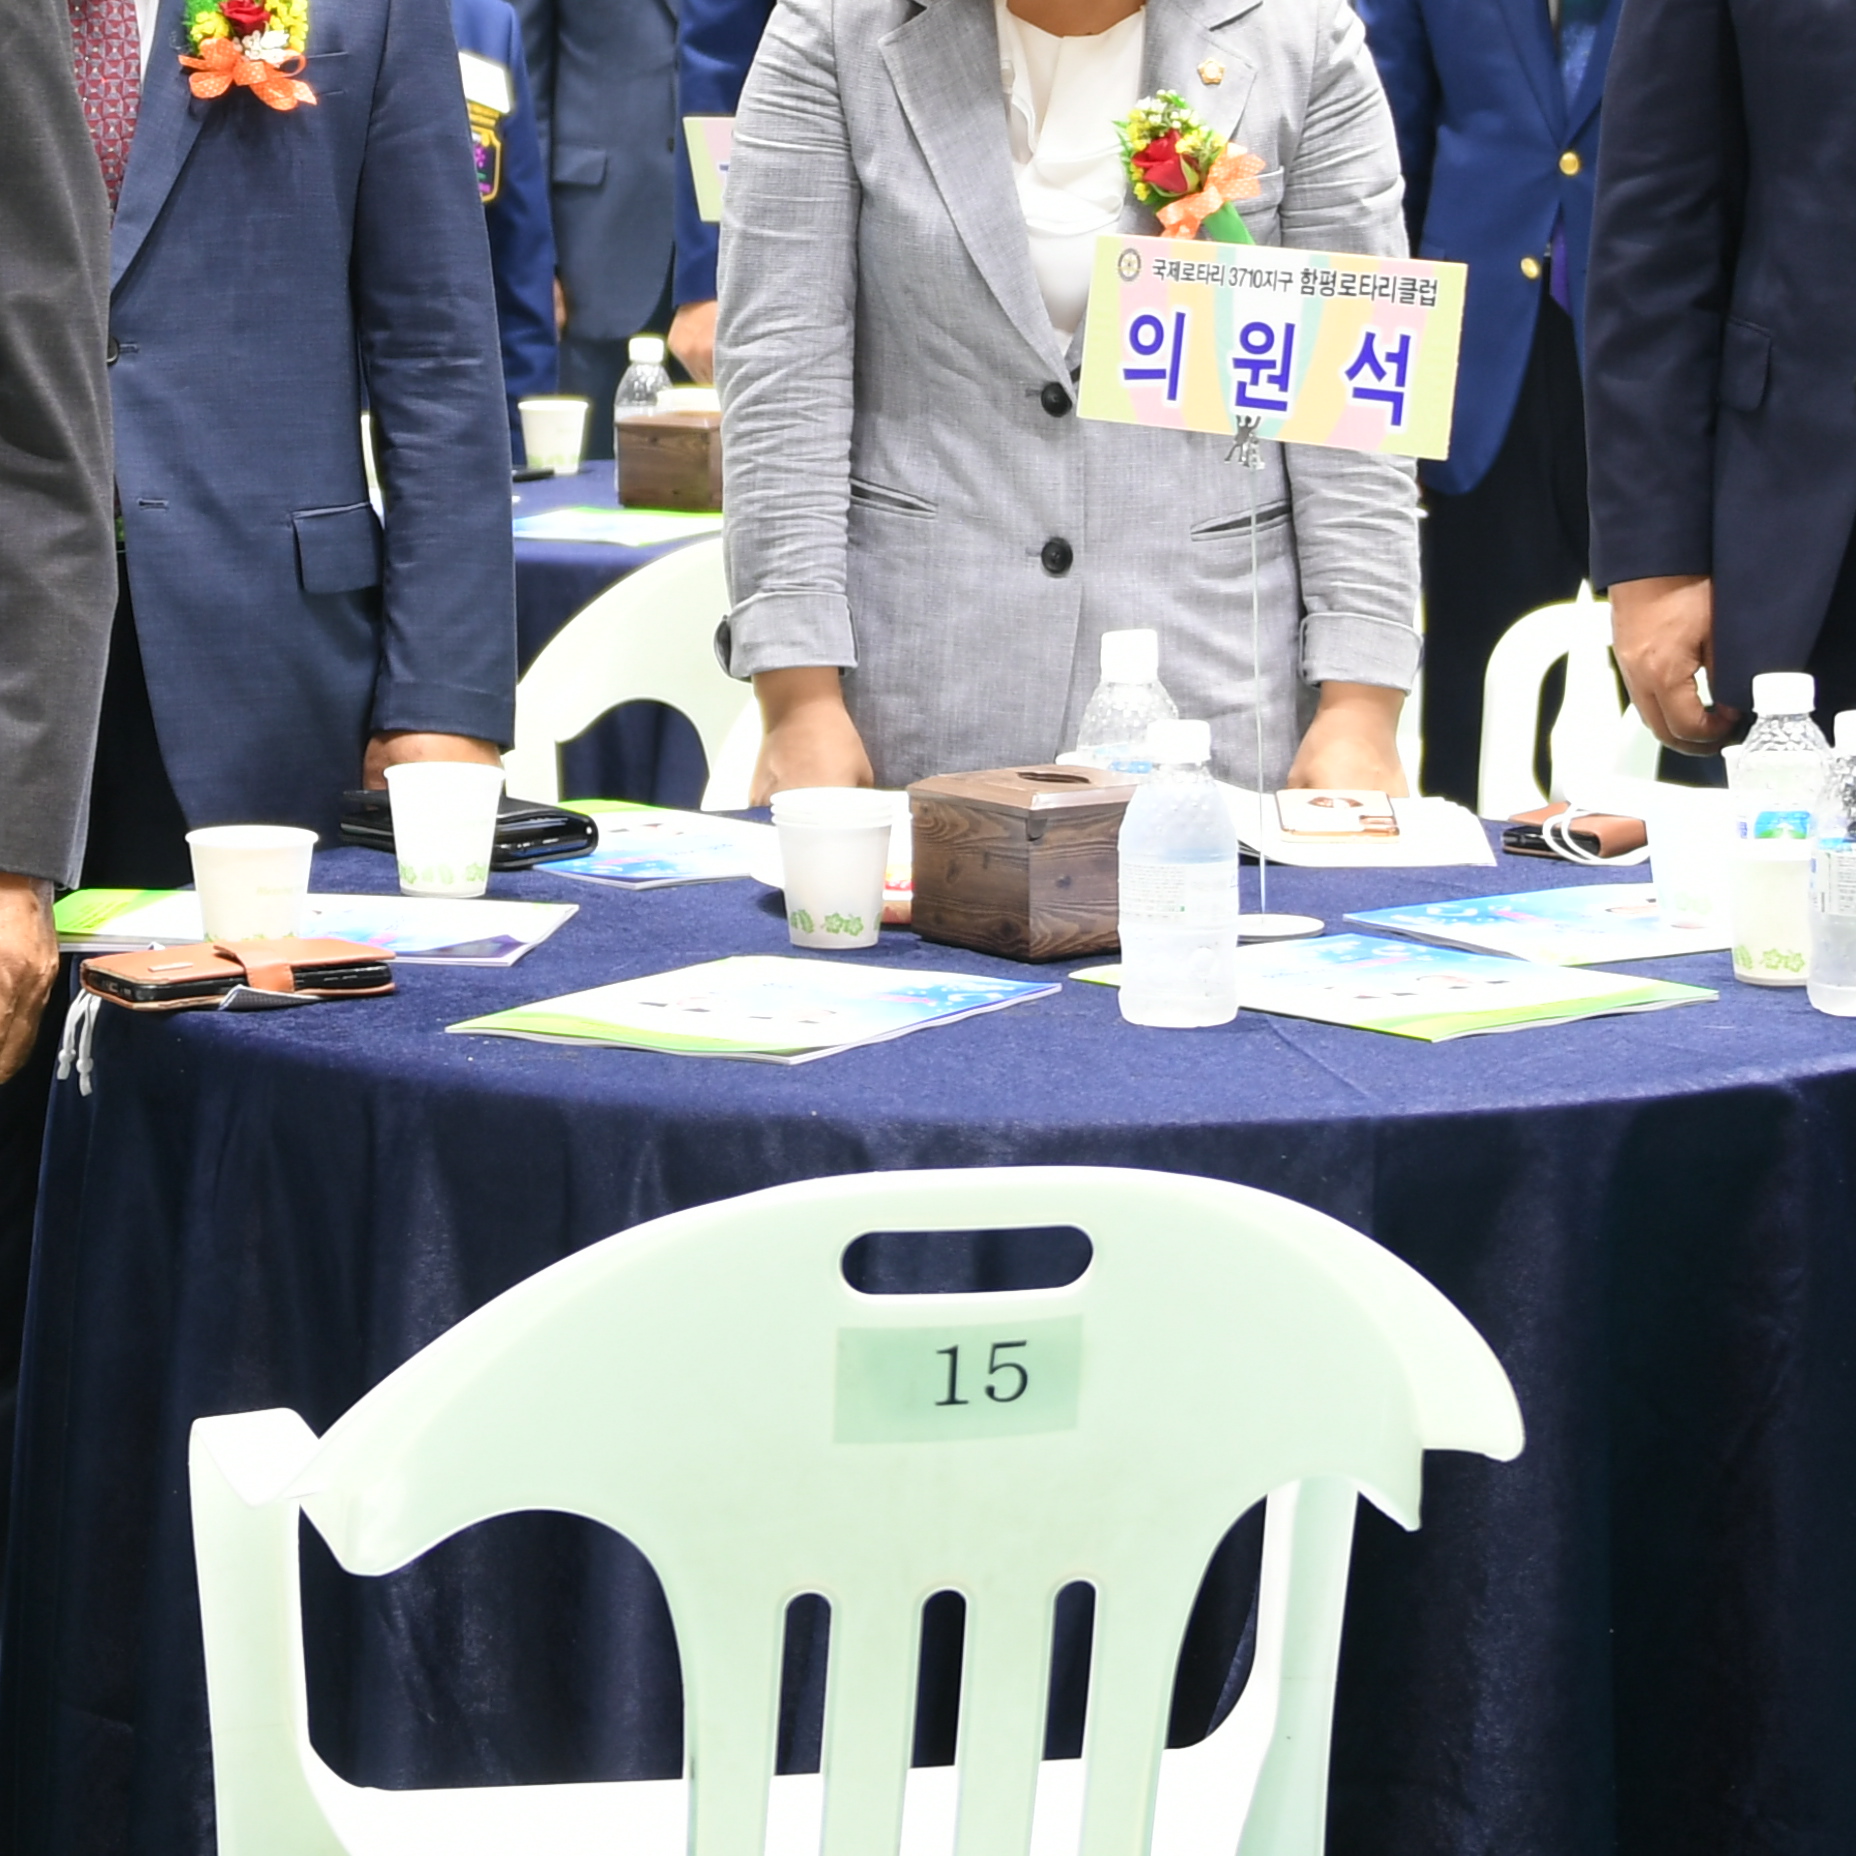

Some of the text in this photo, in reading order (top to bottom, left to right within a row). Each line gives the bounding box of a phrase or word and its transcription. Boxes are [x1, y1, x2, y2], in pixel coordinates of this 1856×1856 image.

[1152, 258, 1438, 307] 국제로타리 3710지구 함평로타리클럽
[933, 1339, 1030, 1407] 15
